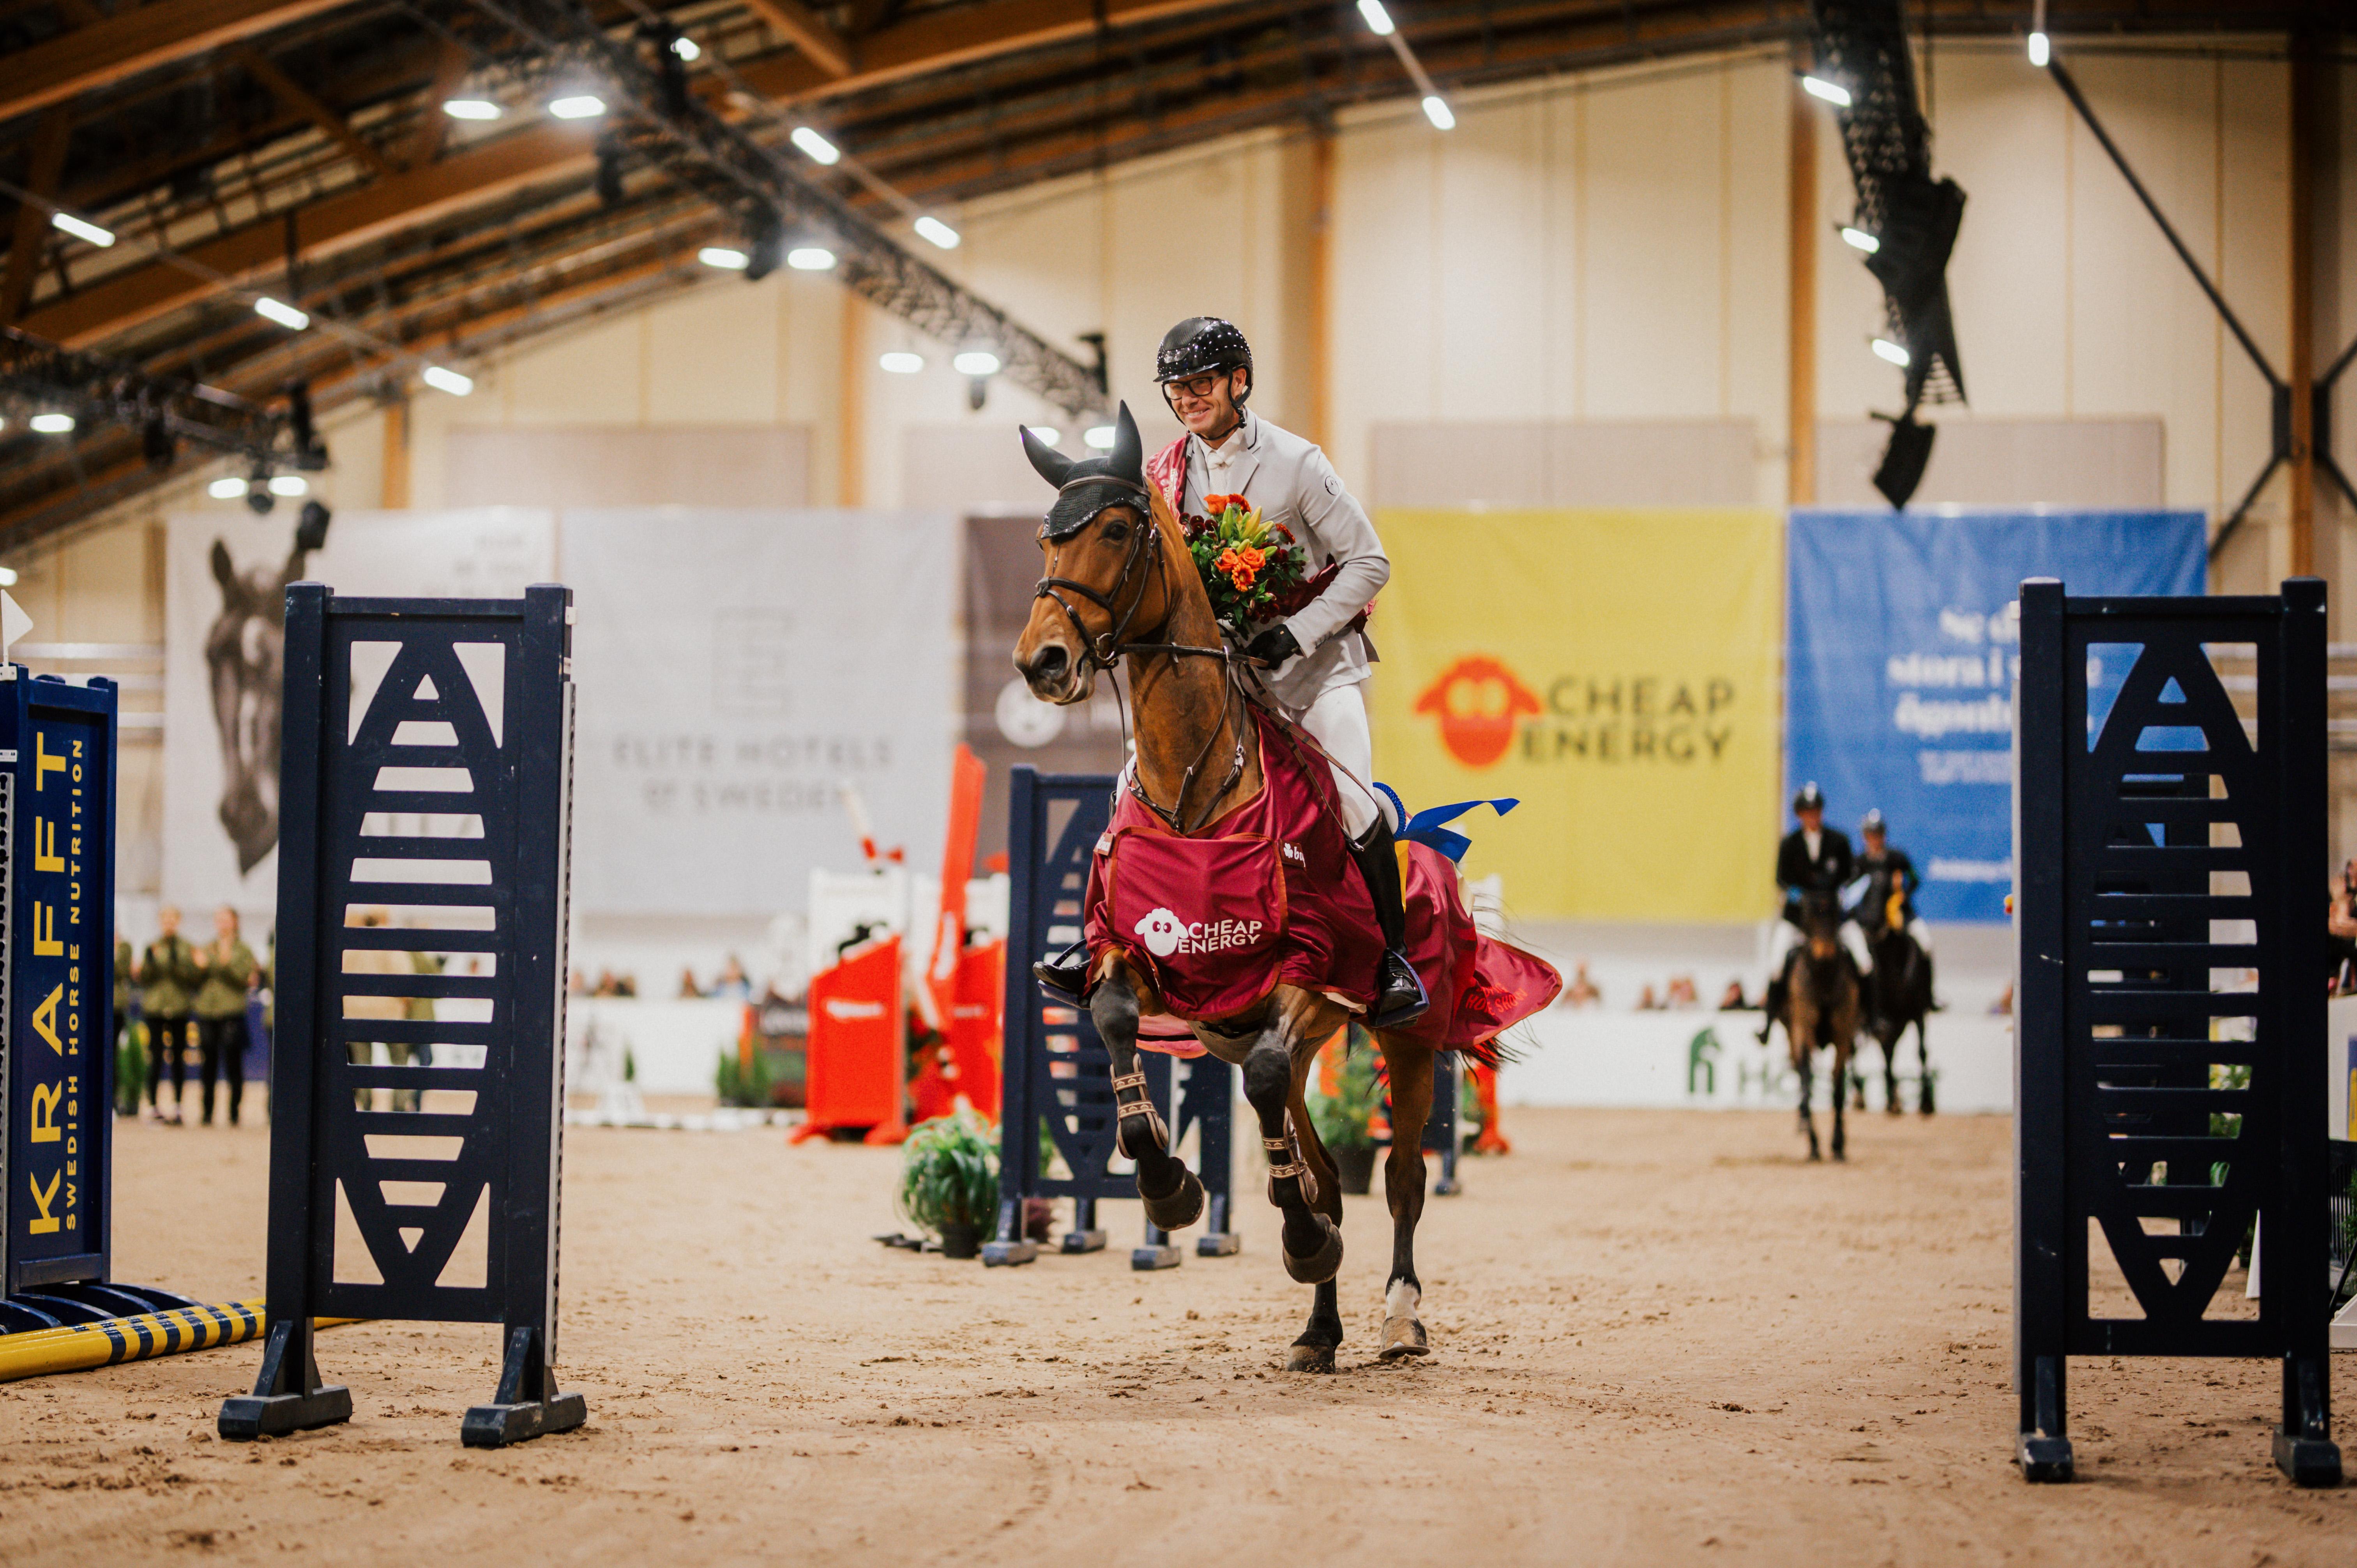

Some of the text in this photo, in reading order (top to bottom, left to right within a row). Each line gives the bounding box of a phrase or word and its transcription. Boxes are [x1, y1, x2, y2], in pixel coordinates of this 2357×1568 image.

[1548, 676, 1735, 716] CHEAP
[1522, 723, 1731, 765] ENERGY
[1178, 934, 1260, 954] ENERGY
[1188, 919, 1262, 939] CHEAP
[30, 731, 67, 1234] KRAFFT
[66, 740, 82, 1230] SWEDISH HORSE NUTRITION
[1495, 988, 1528, 1013] SHOW
